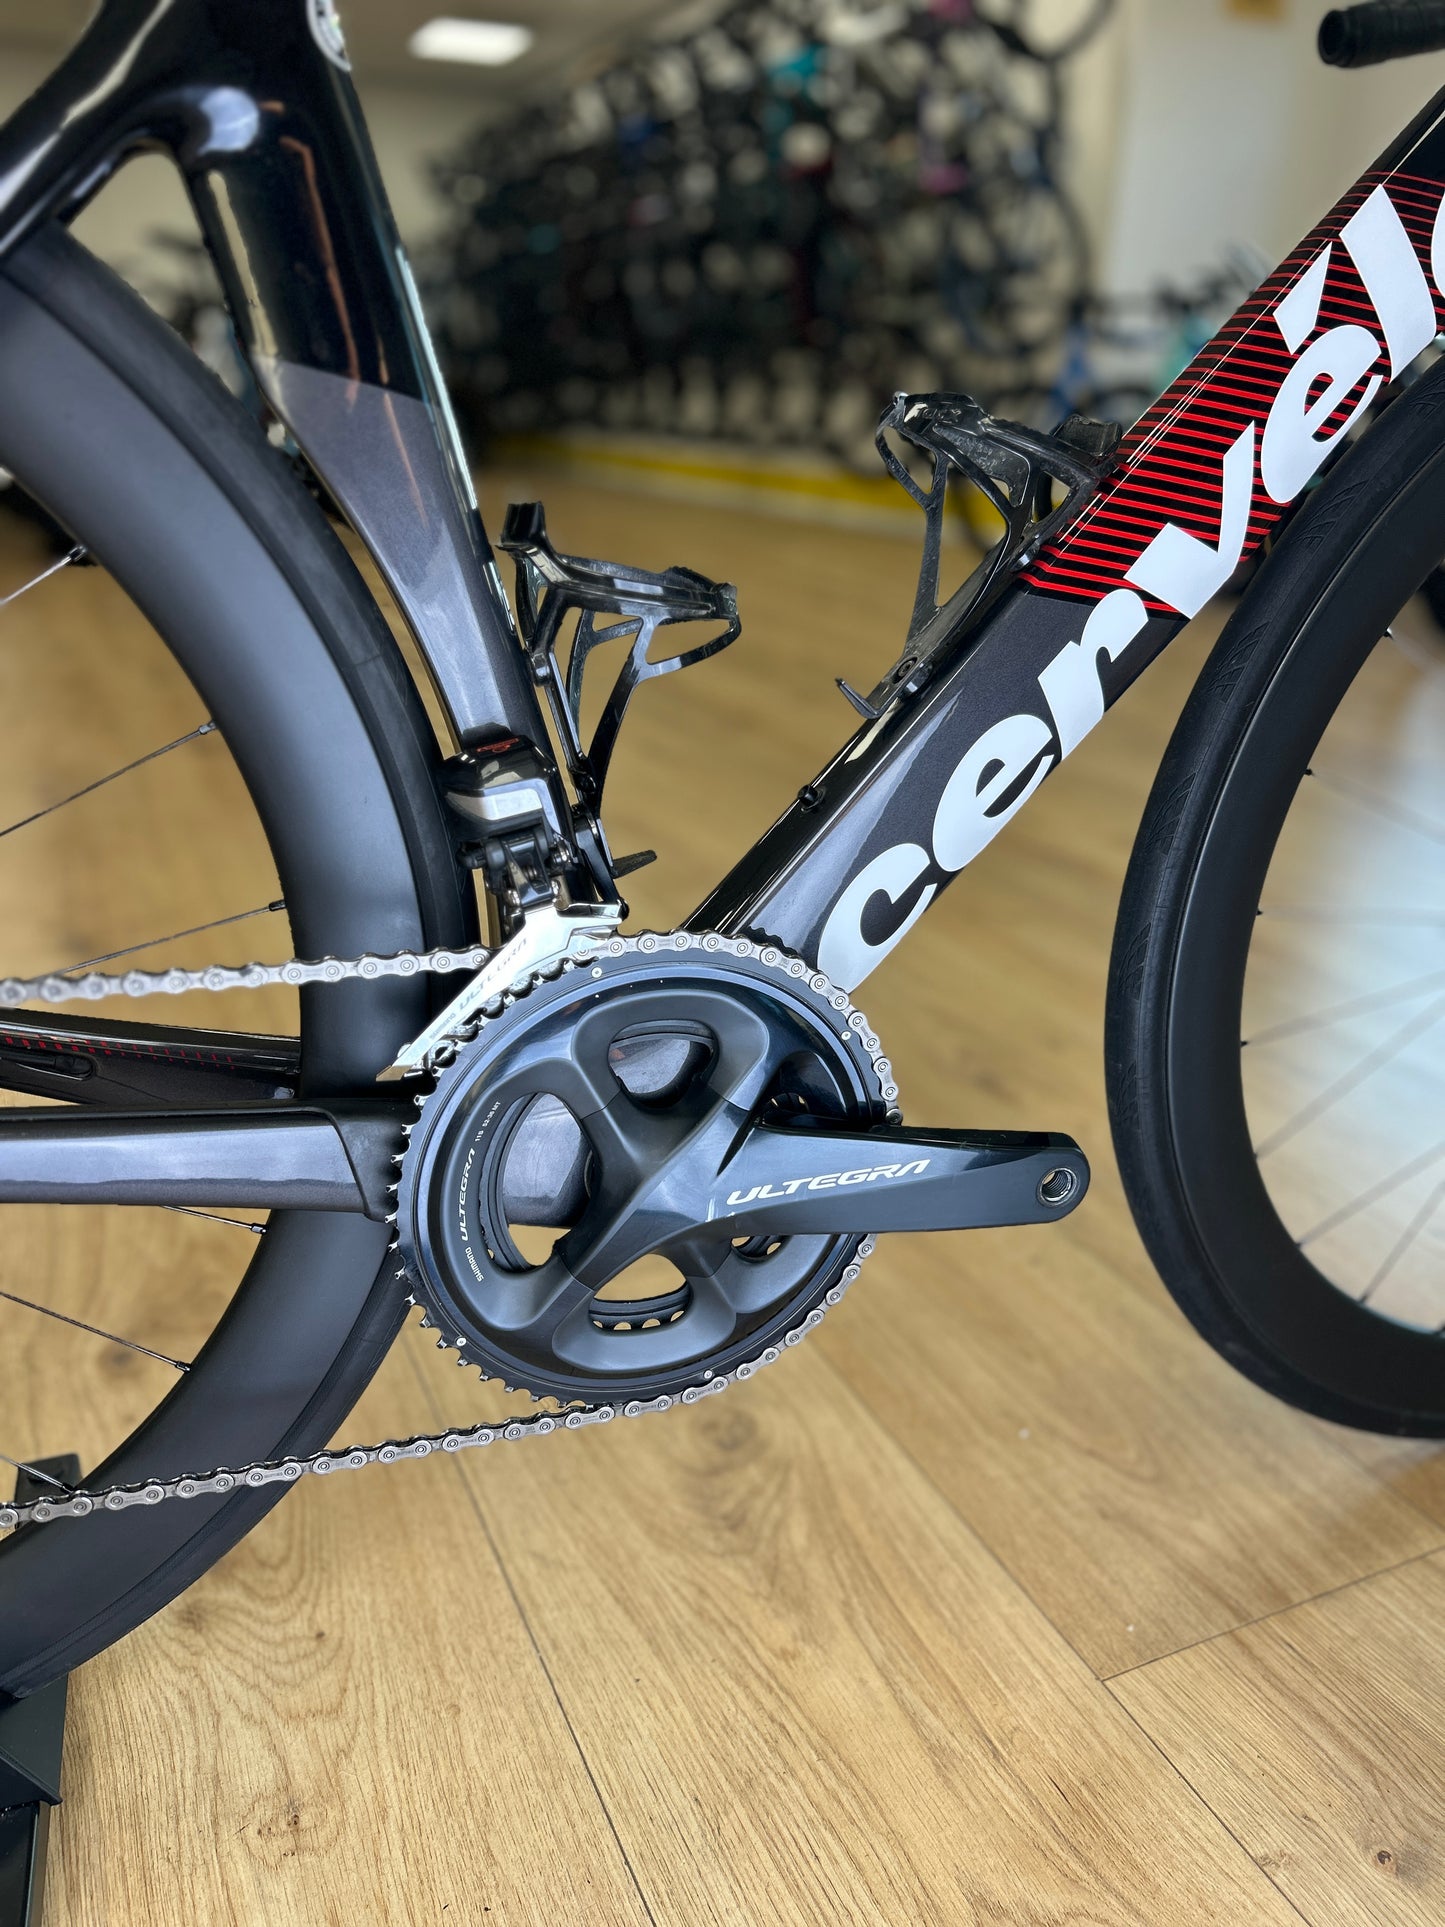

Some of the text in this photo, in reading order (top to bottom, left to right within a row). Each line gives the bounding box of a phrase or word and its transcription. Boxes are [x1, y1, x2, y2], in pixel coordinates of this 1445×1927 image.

[817, 183, 1445, 994] cervél
[458, 1147, 476, 1242] ULTEGRA
[726, 1159, 931, 1206] ULTEGRA
[465, 1246, 484, 1282] SHIMANO
